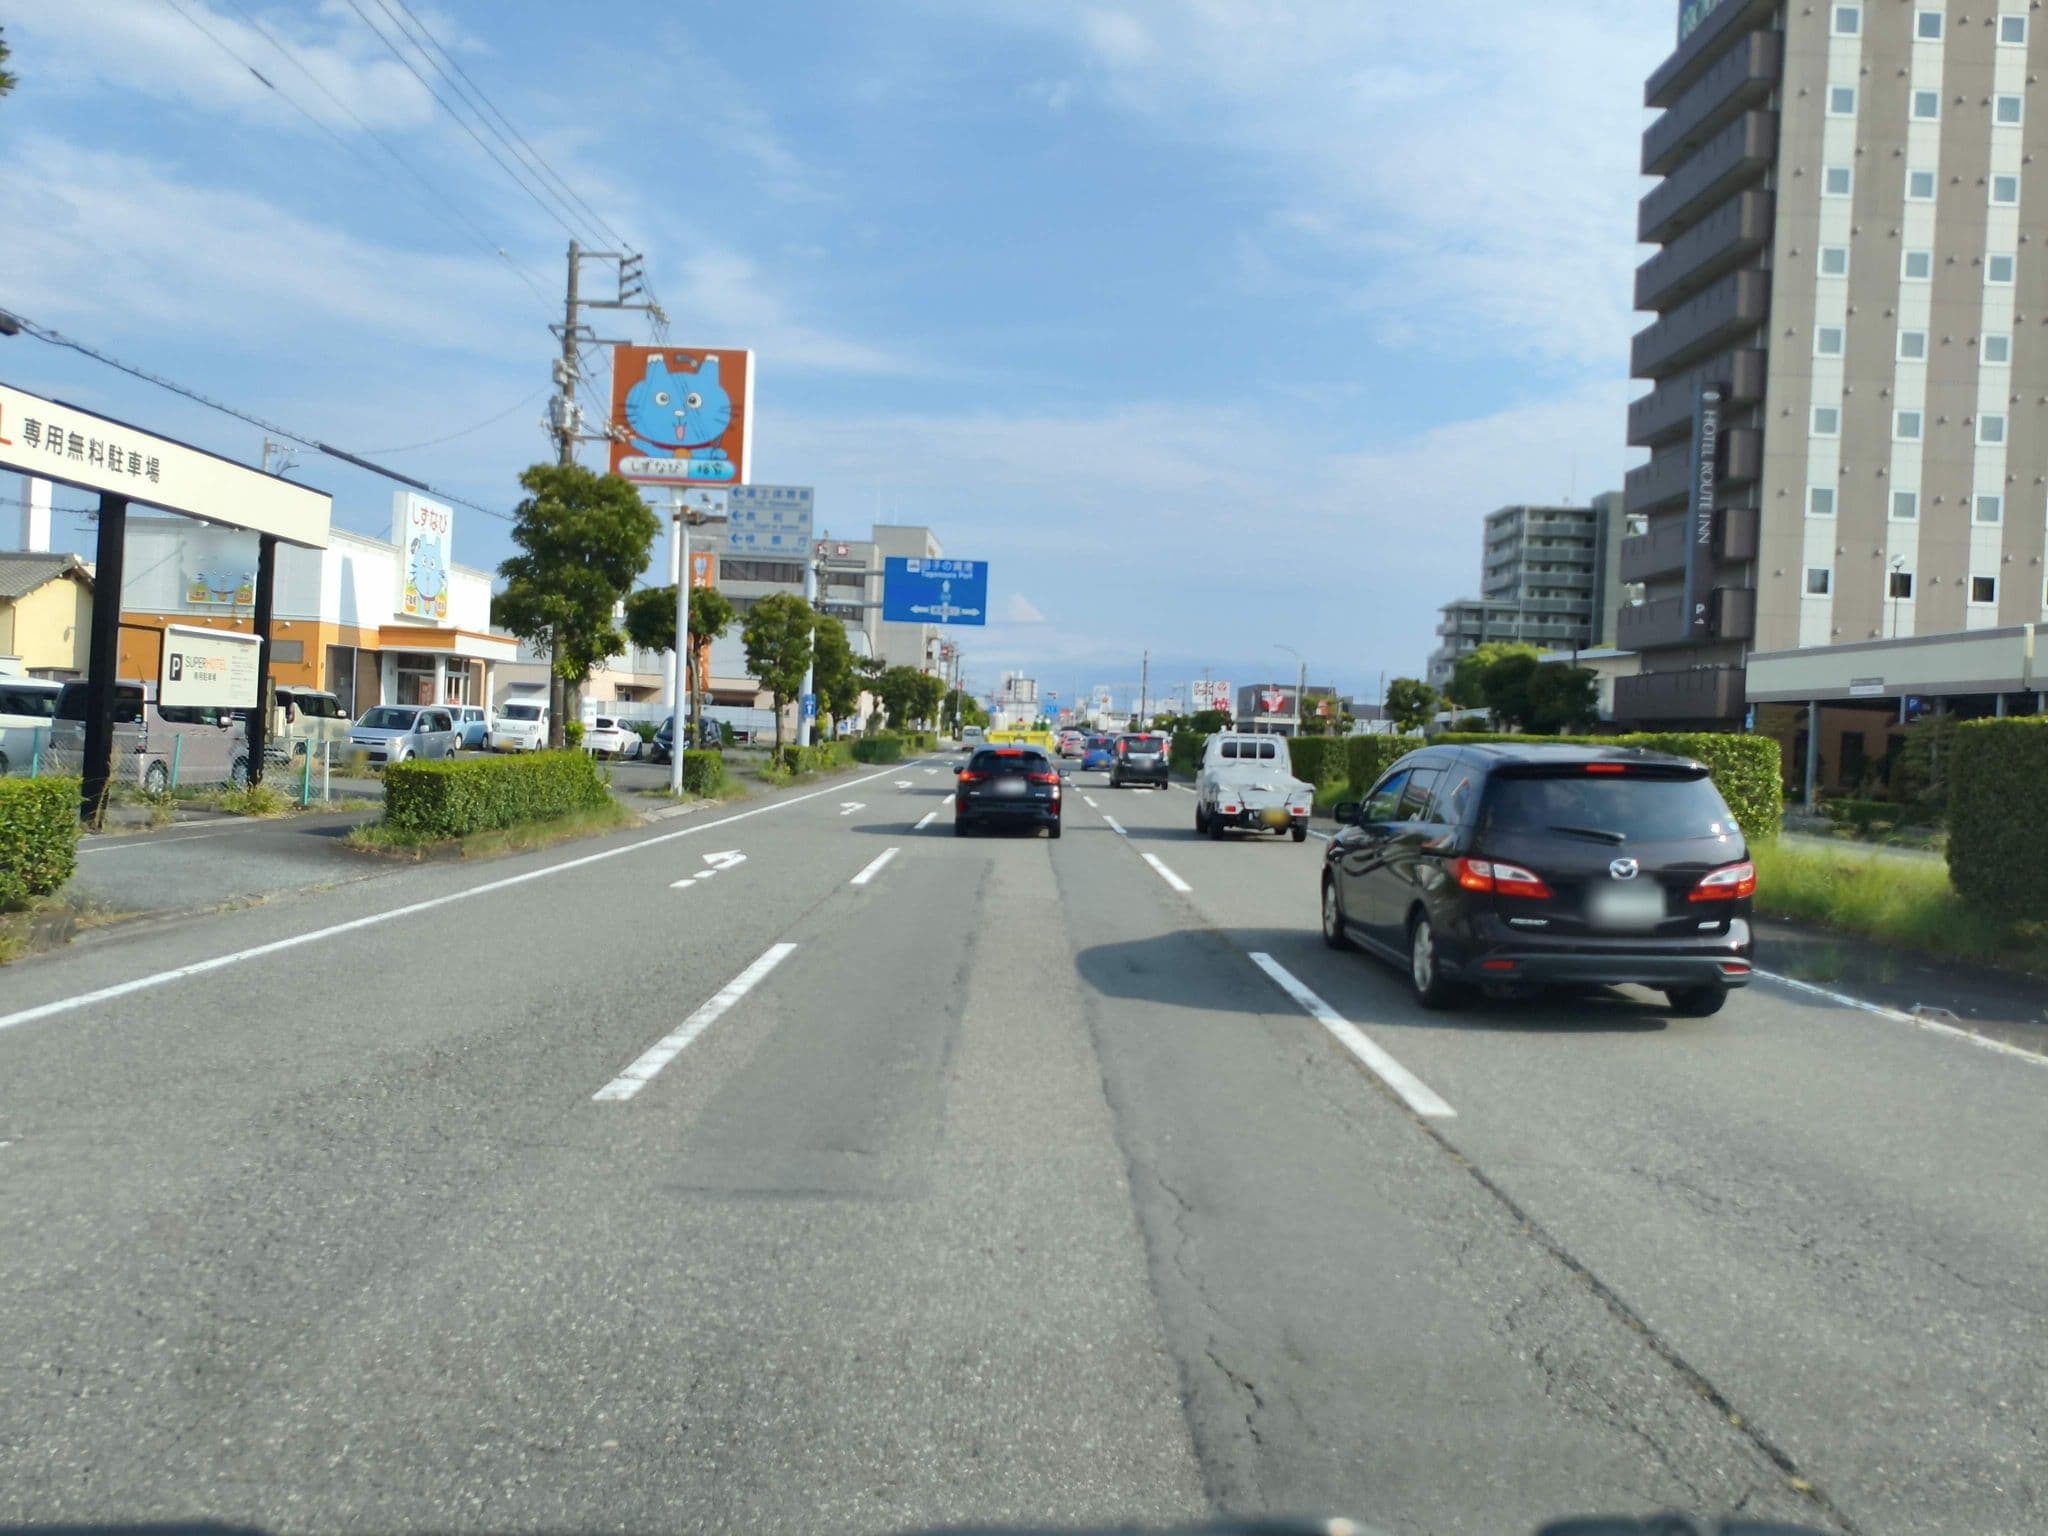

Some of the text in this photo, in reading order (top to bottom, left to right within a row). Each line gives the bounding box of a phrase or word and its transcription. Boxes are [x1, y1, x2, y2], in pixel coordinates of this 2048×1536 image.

[23, 417, 160, 484] 専用無料駐車場
[1701, 410, 1717, 457] HOTEL
